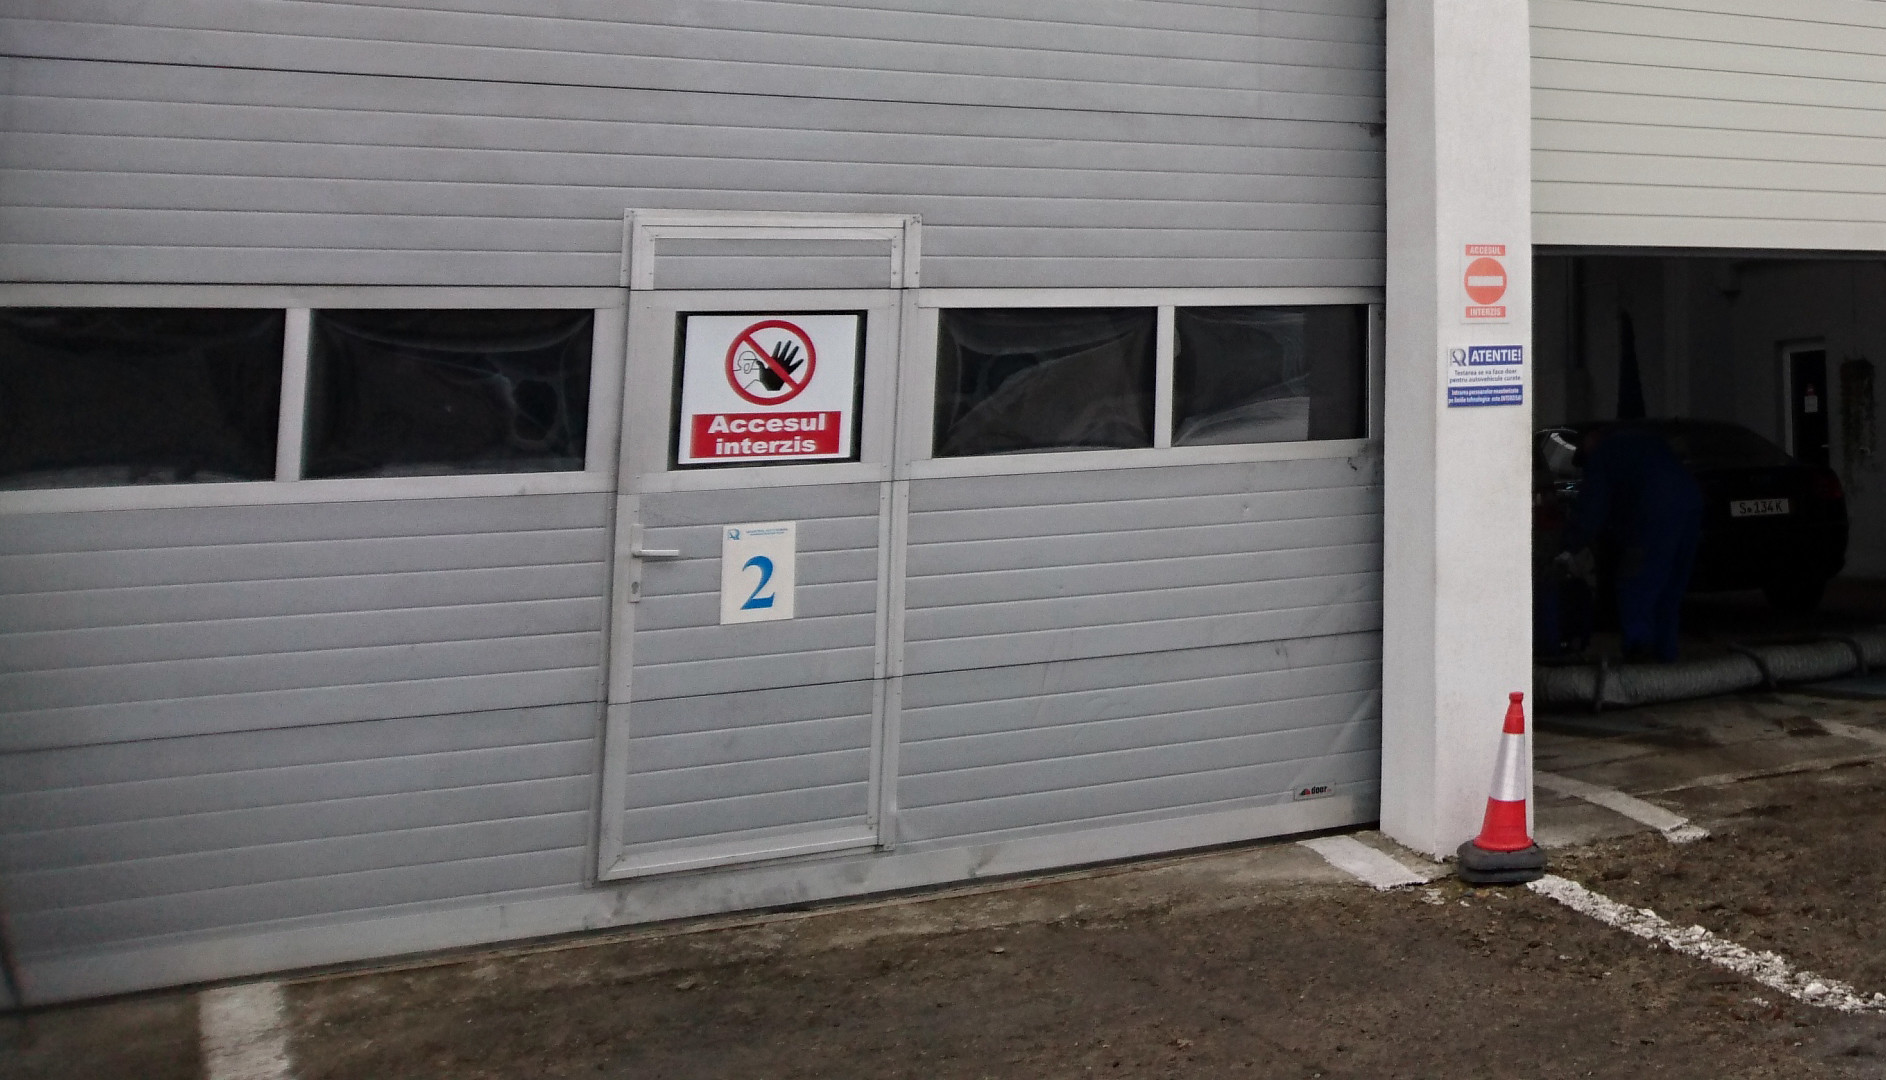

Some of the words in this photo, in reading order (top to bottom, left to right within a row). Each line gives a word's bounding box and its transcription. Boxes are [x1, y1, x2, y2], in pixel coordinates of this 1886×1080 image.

[1469, 246, 1501, 255] ACCESUL
[1470, 307, 1501, 316] INTERZIS
[1471, 349, 1521, 362] ATENTIE!
[707, 413, 826, 434] Accesul
[715, 436, 817, 455] interzis
[740, 555, 775, 610] 2
